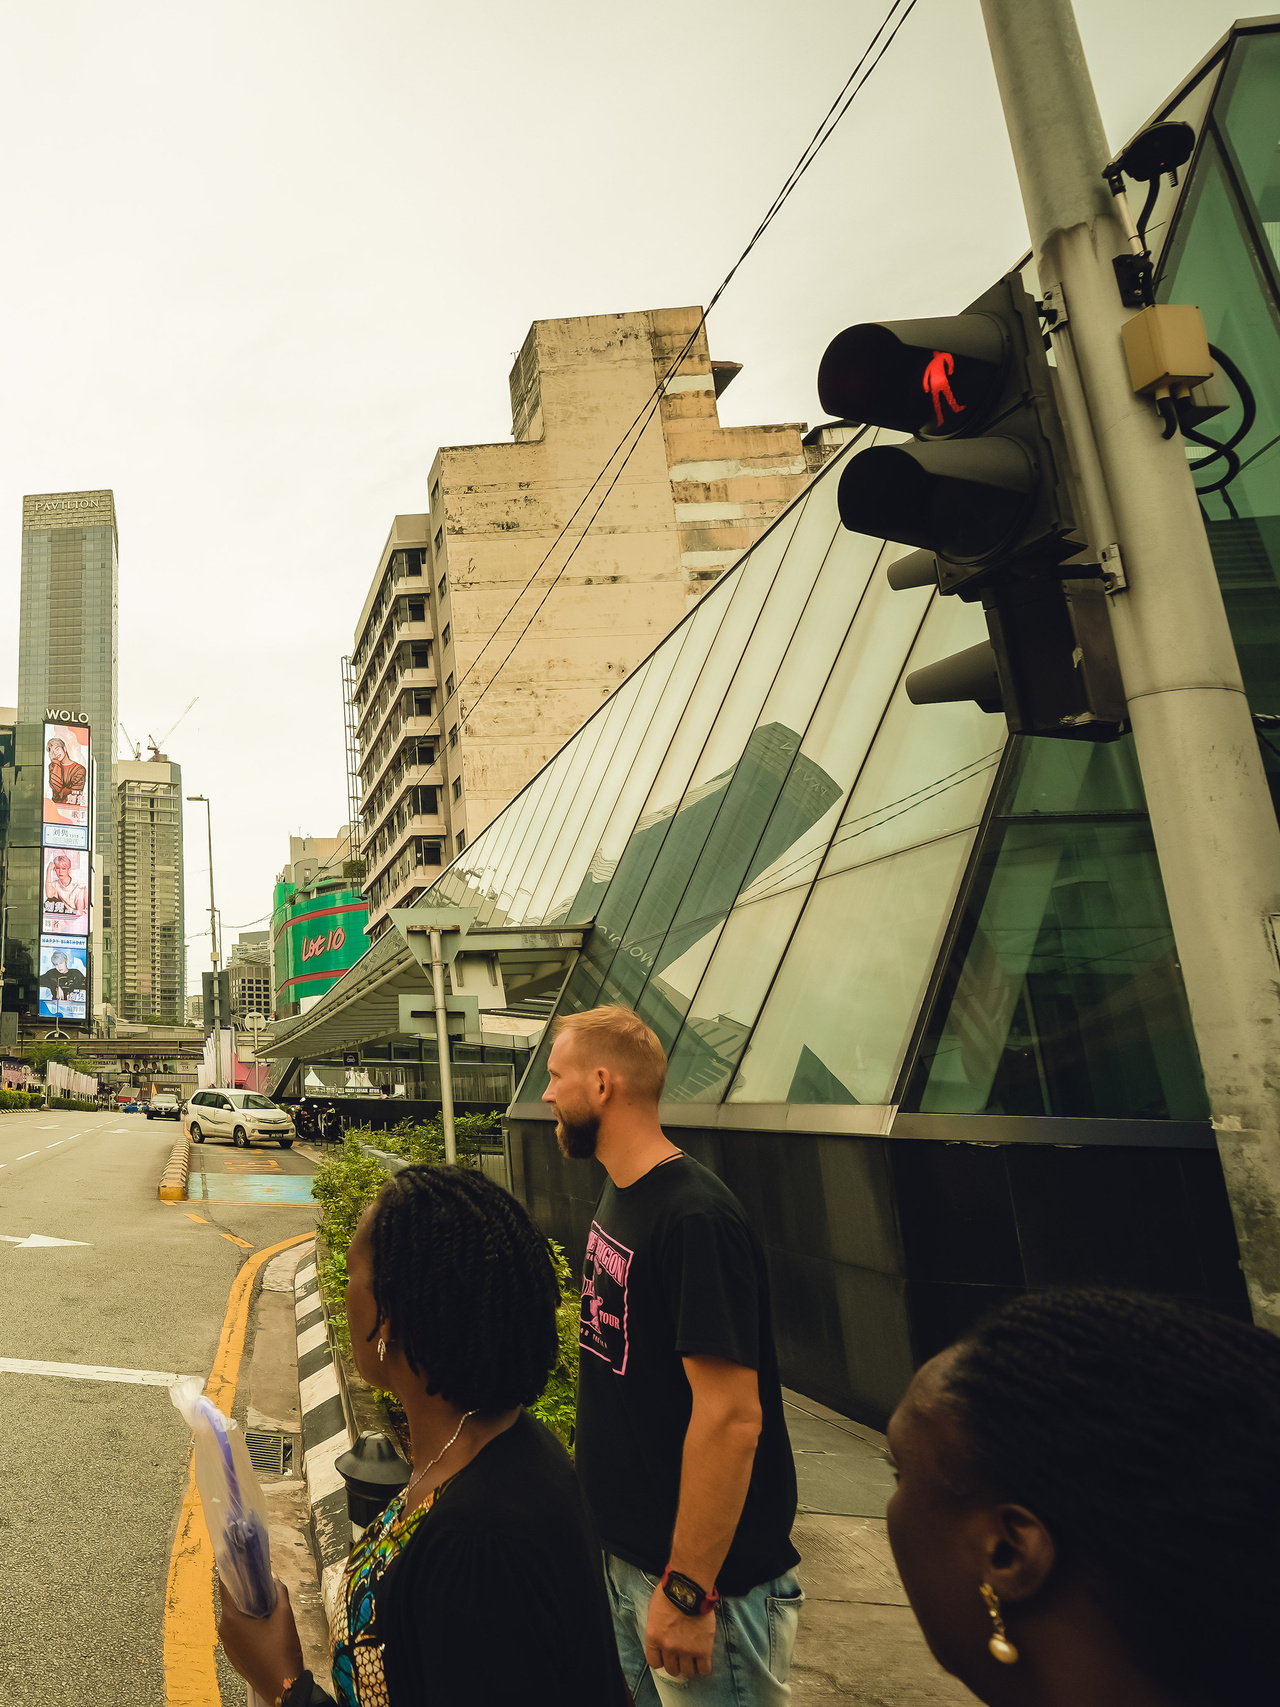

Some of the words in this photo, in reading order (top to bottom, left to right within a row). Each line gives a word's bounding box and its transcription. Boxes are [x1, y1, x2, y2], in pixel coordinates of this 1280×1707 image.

[35, 499, 101, 512] PAVILION
[46, 708, 89, 724] WOLO
[301, 936, 326, 963] Lot
[326, 926, 347, 952] 10
[599, 1309, 620, 1331] TOUR
